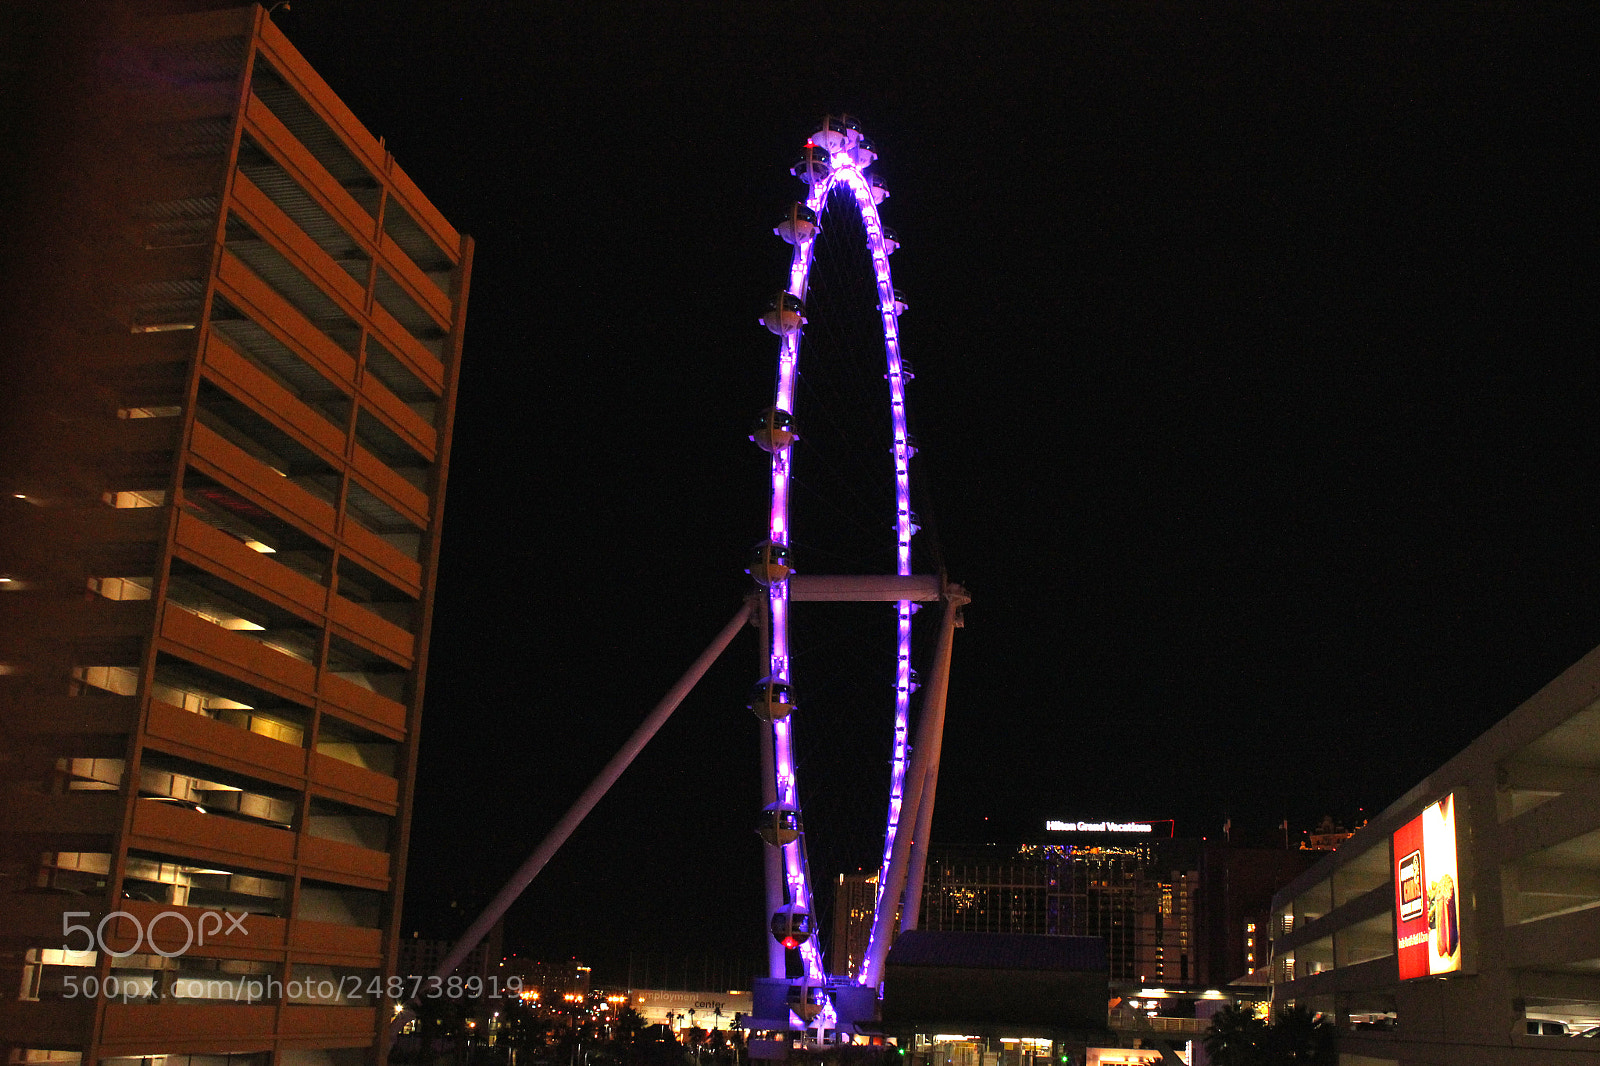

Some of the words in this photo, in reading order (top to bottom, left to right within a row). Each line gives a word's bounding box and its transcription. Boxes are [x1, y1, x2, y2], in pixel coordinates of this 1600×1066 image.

[1046, 821, 1076, 831] Hilton
[1077, 822, 1105, 831] Grand
[1106, 822, 1152, 832] Vacations
[639, 991, 699, 1002] employment
[694, 1000, 726, 1009] center
